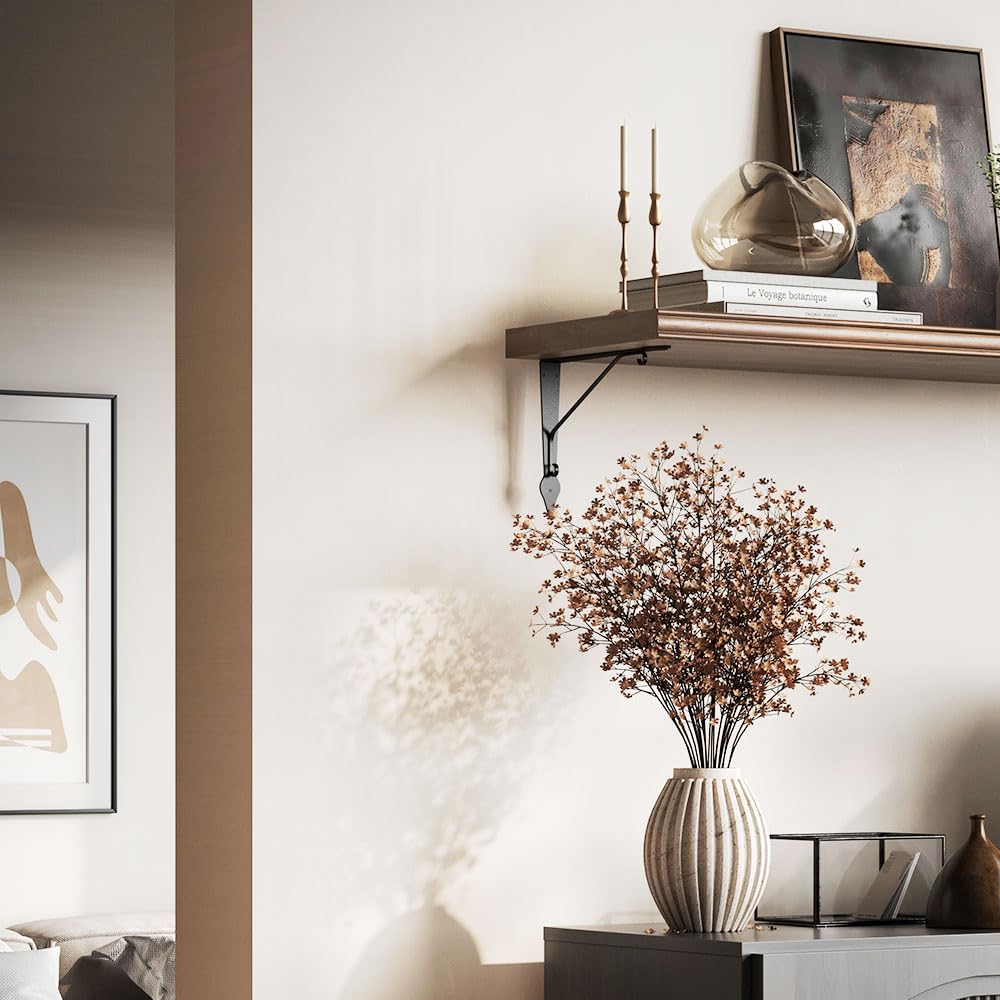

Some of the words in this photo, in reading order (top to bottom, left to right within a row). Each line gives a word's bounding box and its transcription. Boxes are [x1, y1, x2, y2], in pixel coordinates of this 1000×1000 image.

[746, 288, 757, 297] Le
[758, 288, 787, 302] Voyage
[788, 291, 828, 304] botanique
